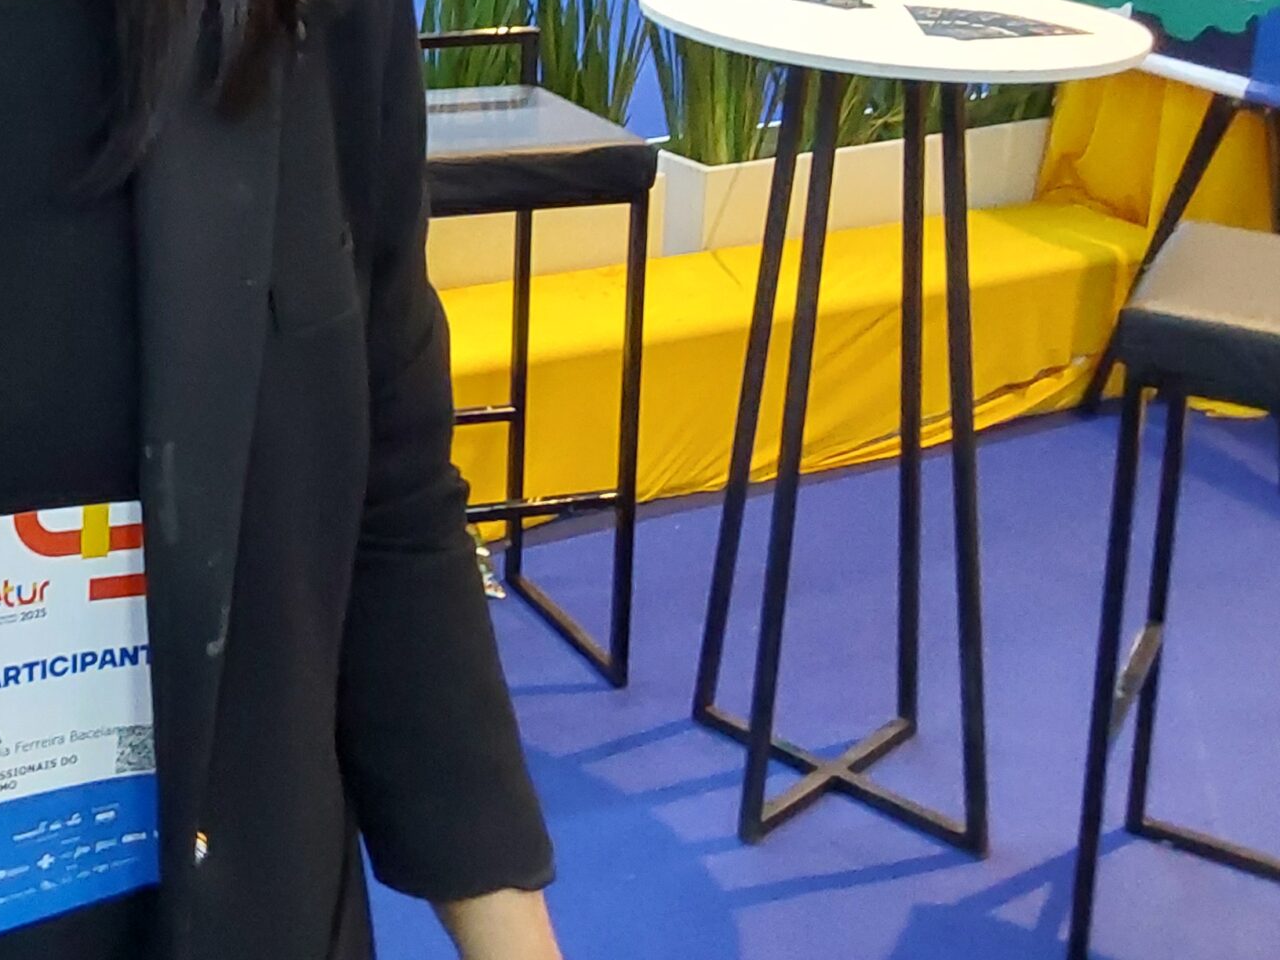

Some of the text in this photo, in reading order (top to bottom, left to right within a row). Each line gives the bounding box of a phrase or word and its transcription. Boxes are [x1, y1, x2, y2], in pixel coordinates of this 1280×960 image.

[20, 607, 47, 621] 2025
[15, 734, 65, 753] Ferreira
[60, 754, 78, 767] DO
